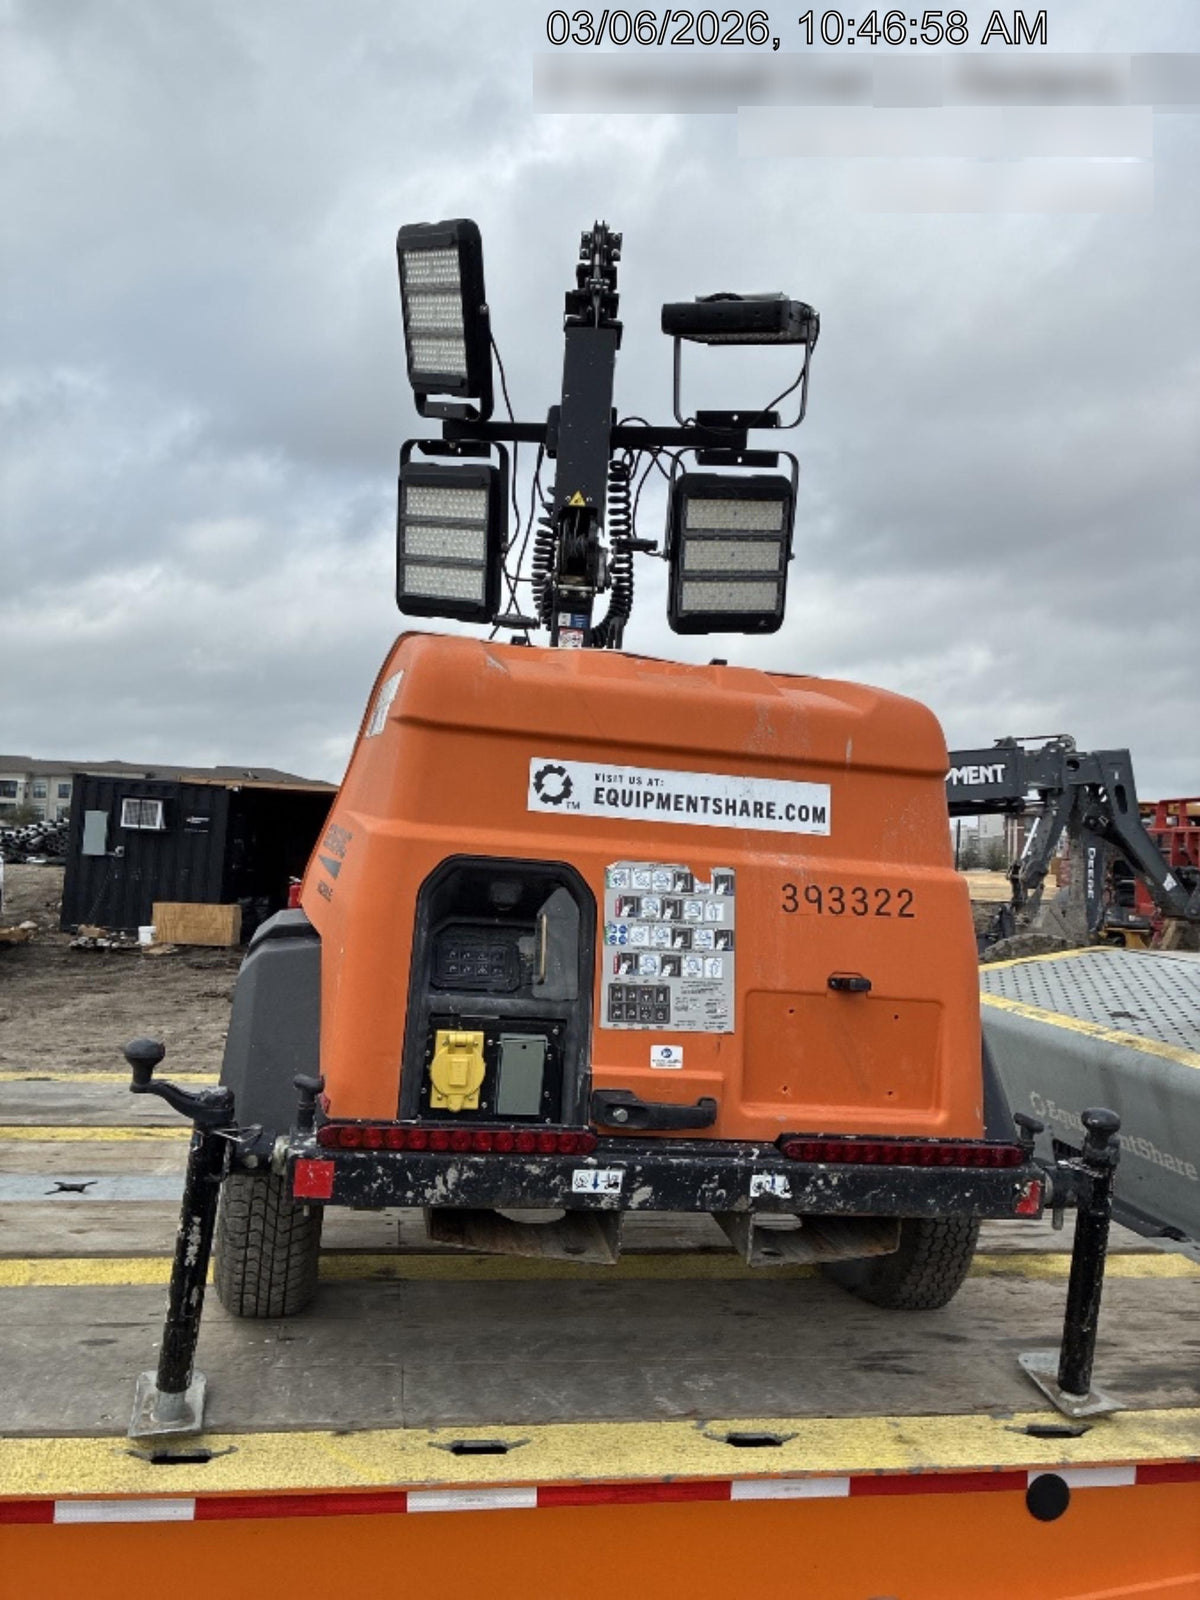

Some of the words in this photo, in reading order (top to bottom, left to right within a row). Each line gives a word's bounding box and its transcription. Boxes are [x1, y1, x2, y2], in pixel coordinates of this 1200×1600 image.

[594, 772, 624, 784] VISIT
[629, 775, 643, 785] US
[647, 777, 665, 787] AT:
[944, 764, 1006, 786] MENT
[593, 787, 826, 824] EQUIPMENTSHARE.COM
[781, 883, 916, 919] 393322
